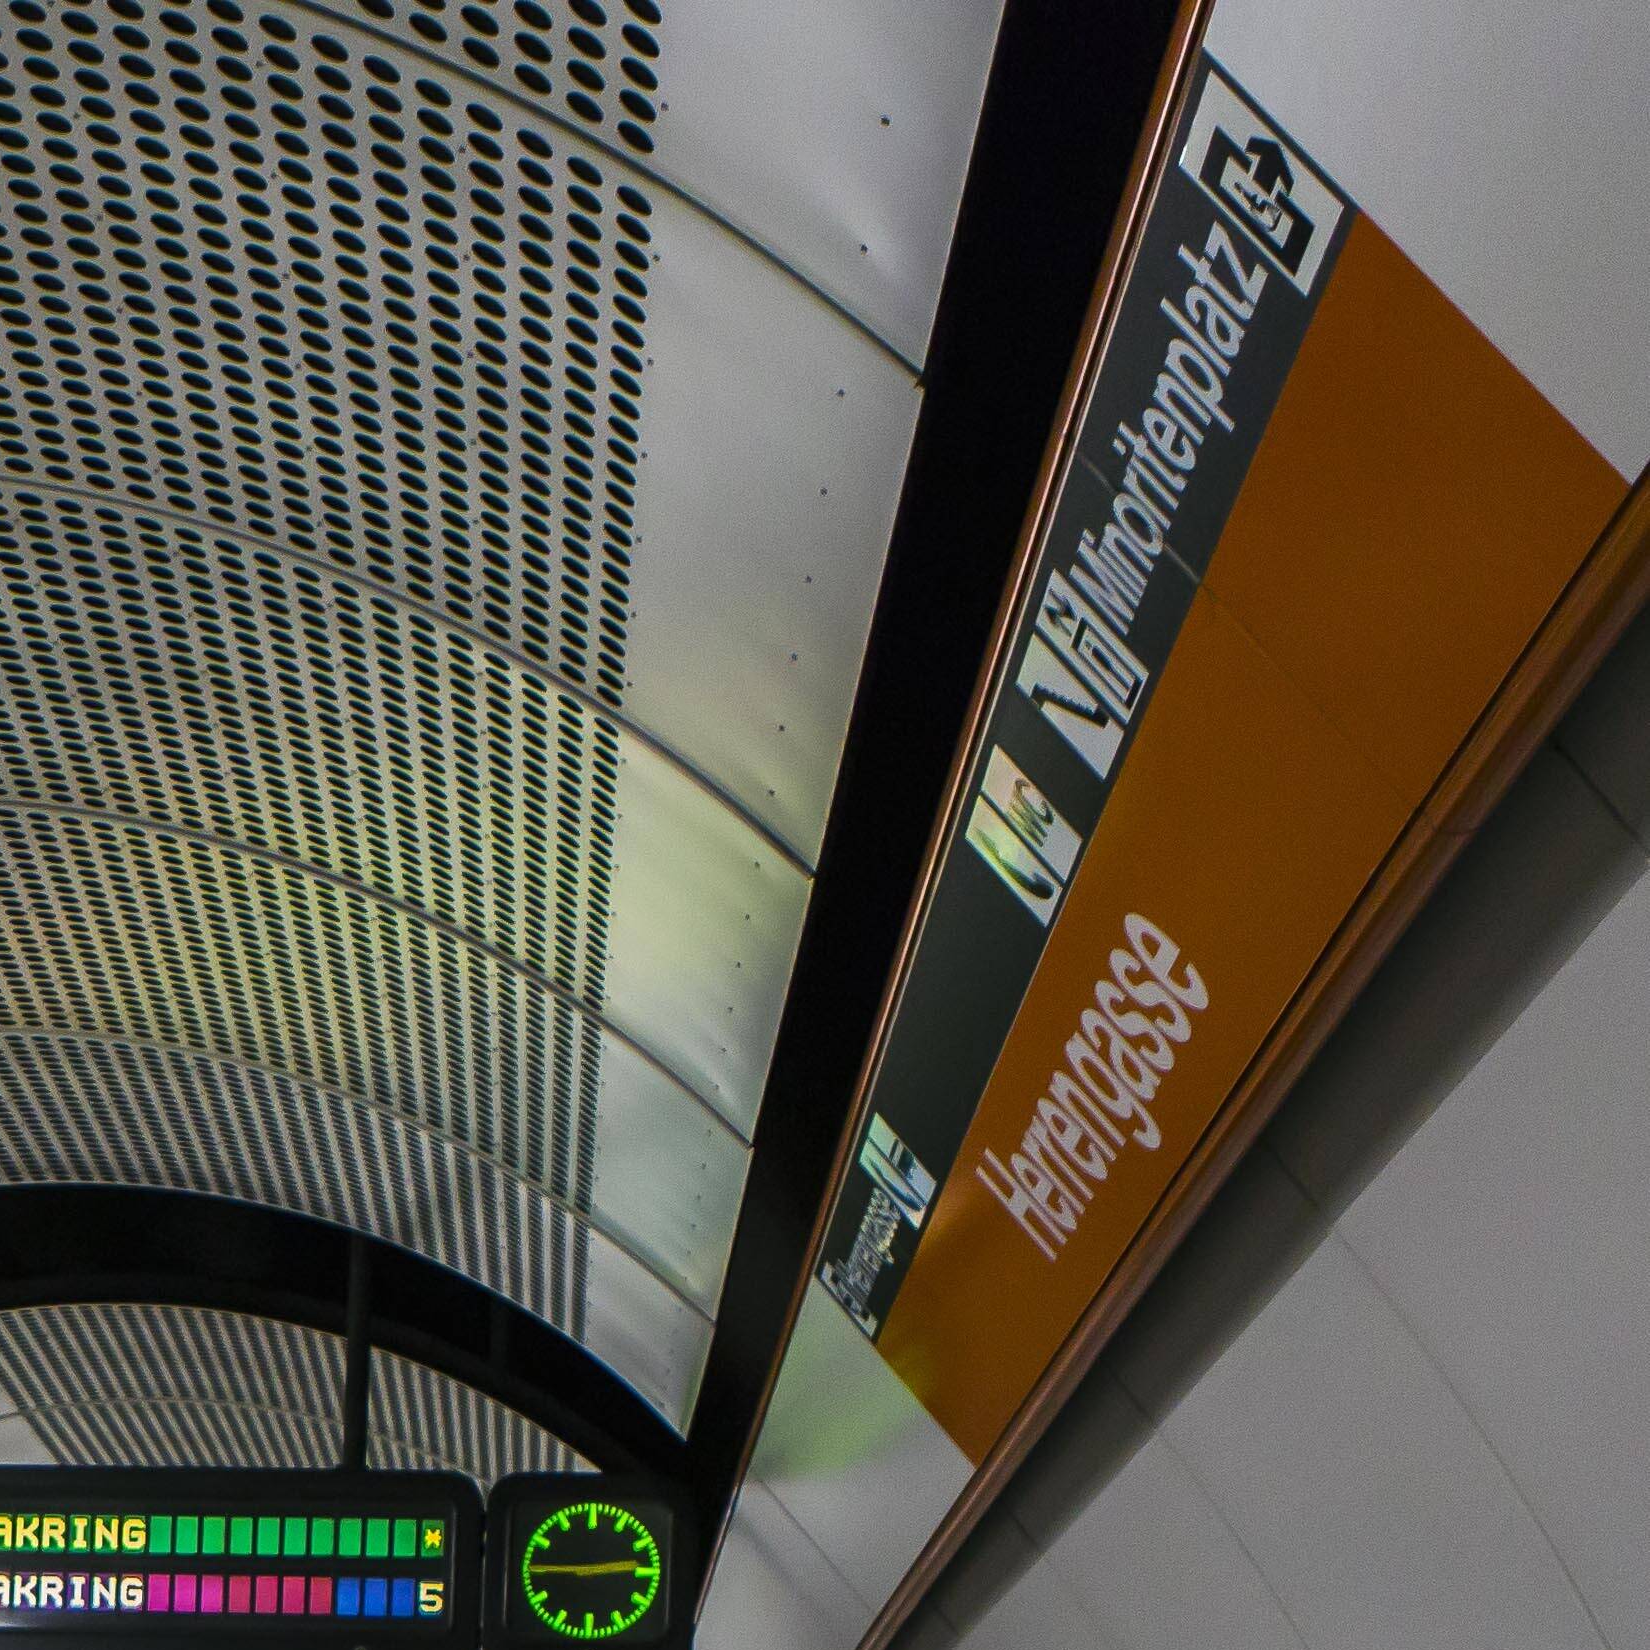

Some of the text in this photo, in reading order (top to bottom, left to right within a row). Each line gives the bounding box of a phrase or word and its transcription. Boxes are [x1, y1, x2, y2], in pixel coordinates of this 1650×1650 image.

[1069, 222, 1268, 636] Minoritenplatz
[975, 912, 1209, 1262] Herrengasse
[419, 1581, 445, 1613] 5
